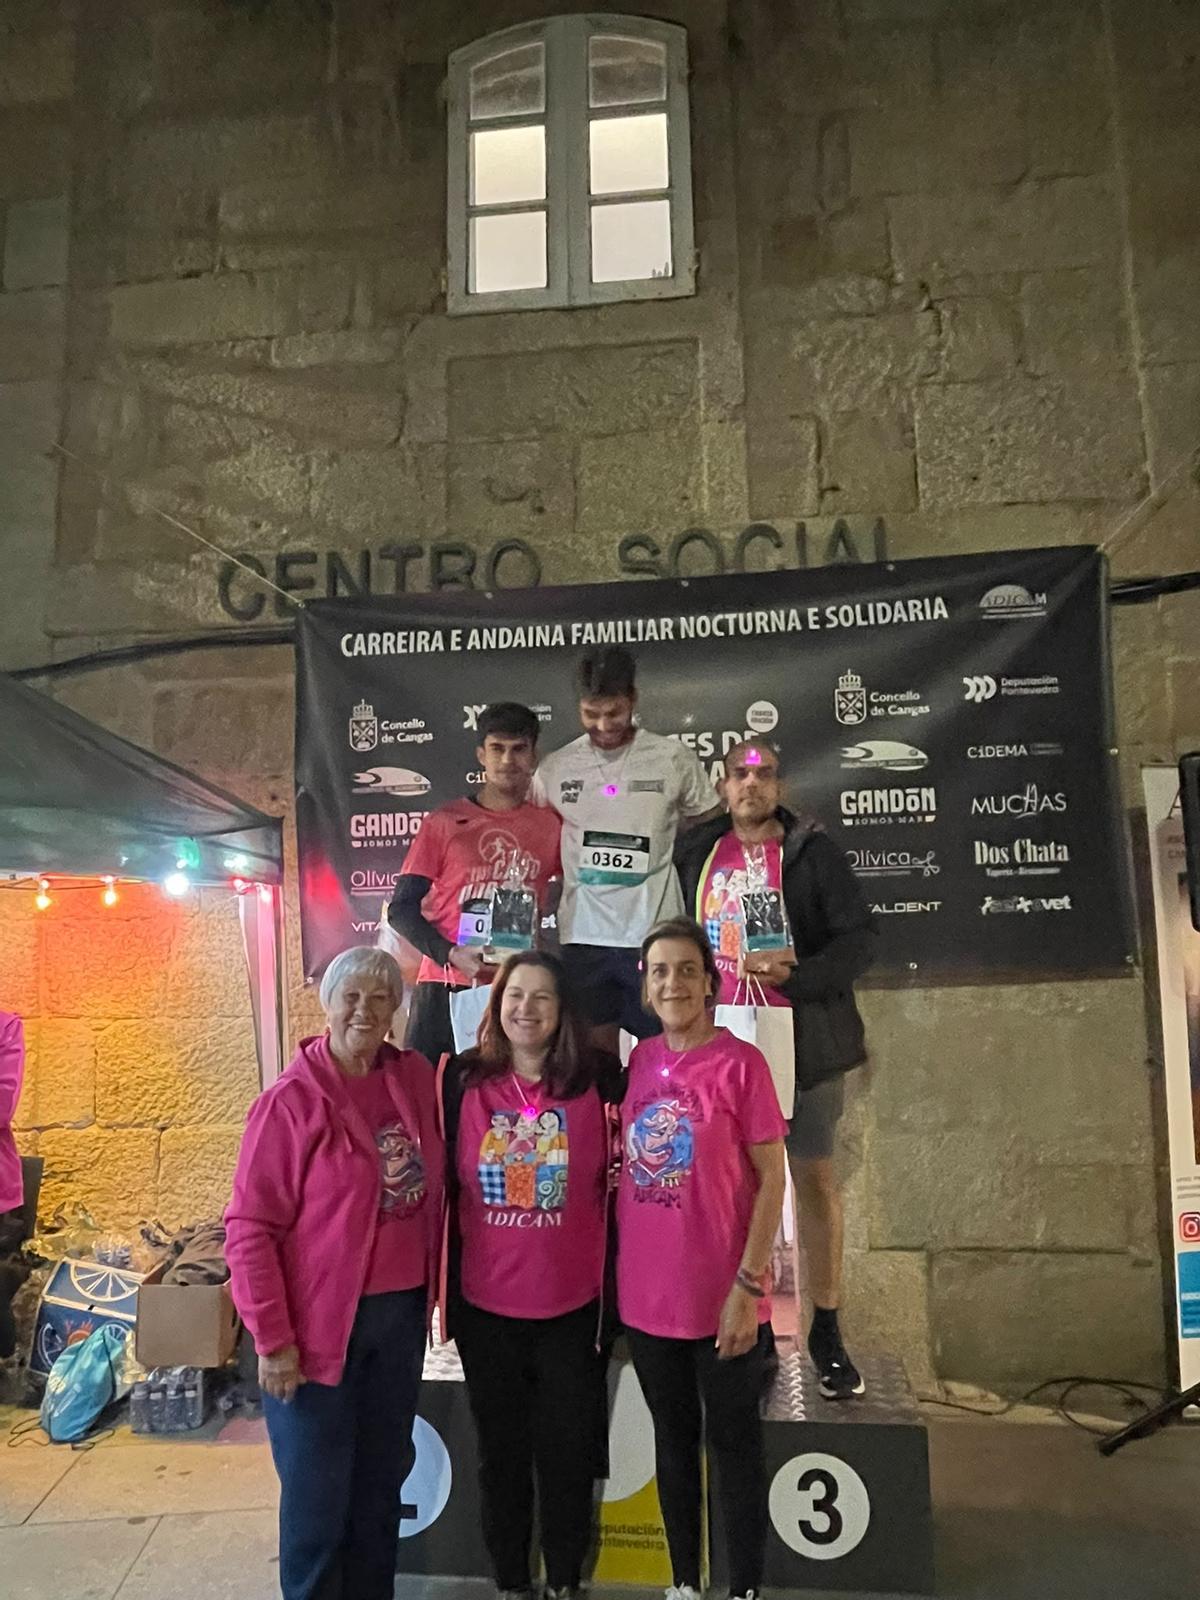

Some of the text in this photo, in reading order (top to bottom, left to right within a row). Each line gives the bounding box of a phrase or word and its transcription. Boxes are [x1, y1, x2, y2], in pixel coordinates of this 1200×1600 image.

[219, 539, 541, 620] CENTRO
[340, 597, 948, 658] CARREIRA E ANDAINA FAMILIAR NOCTURNA E SOLIDARIA
[870, 690, 921, 704] Concello
[870, 702, 930, 718] de Cangas
[381, 718, 425, 731] Concello
[381, 732, 433, 744] de Cangas
[592, 851, 633, 869] 0362
[974, 838, 1070, 865] Dos Chata
[484, 1211, 561, 1228] ADICAM
[797, 1467, 843, 1546] 3
[597, 1537, 665, 1551] ontevedra
